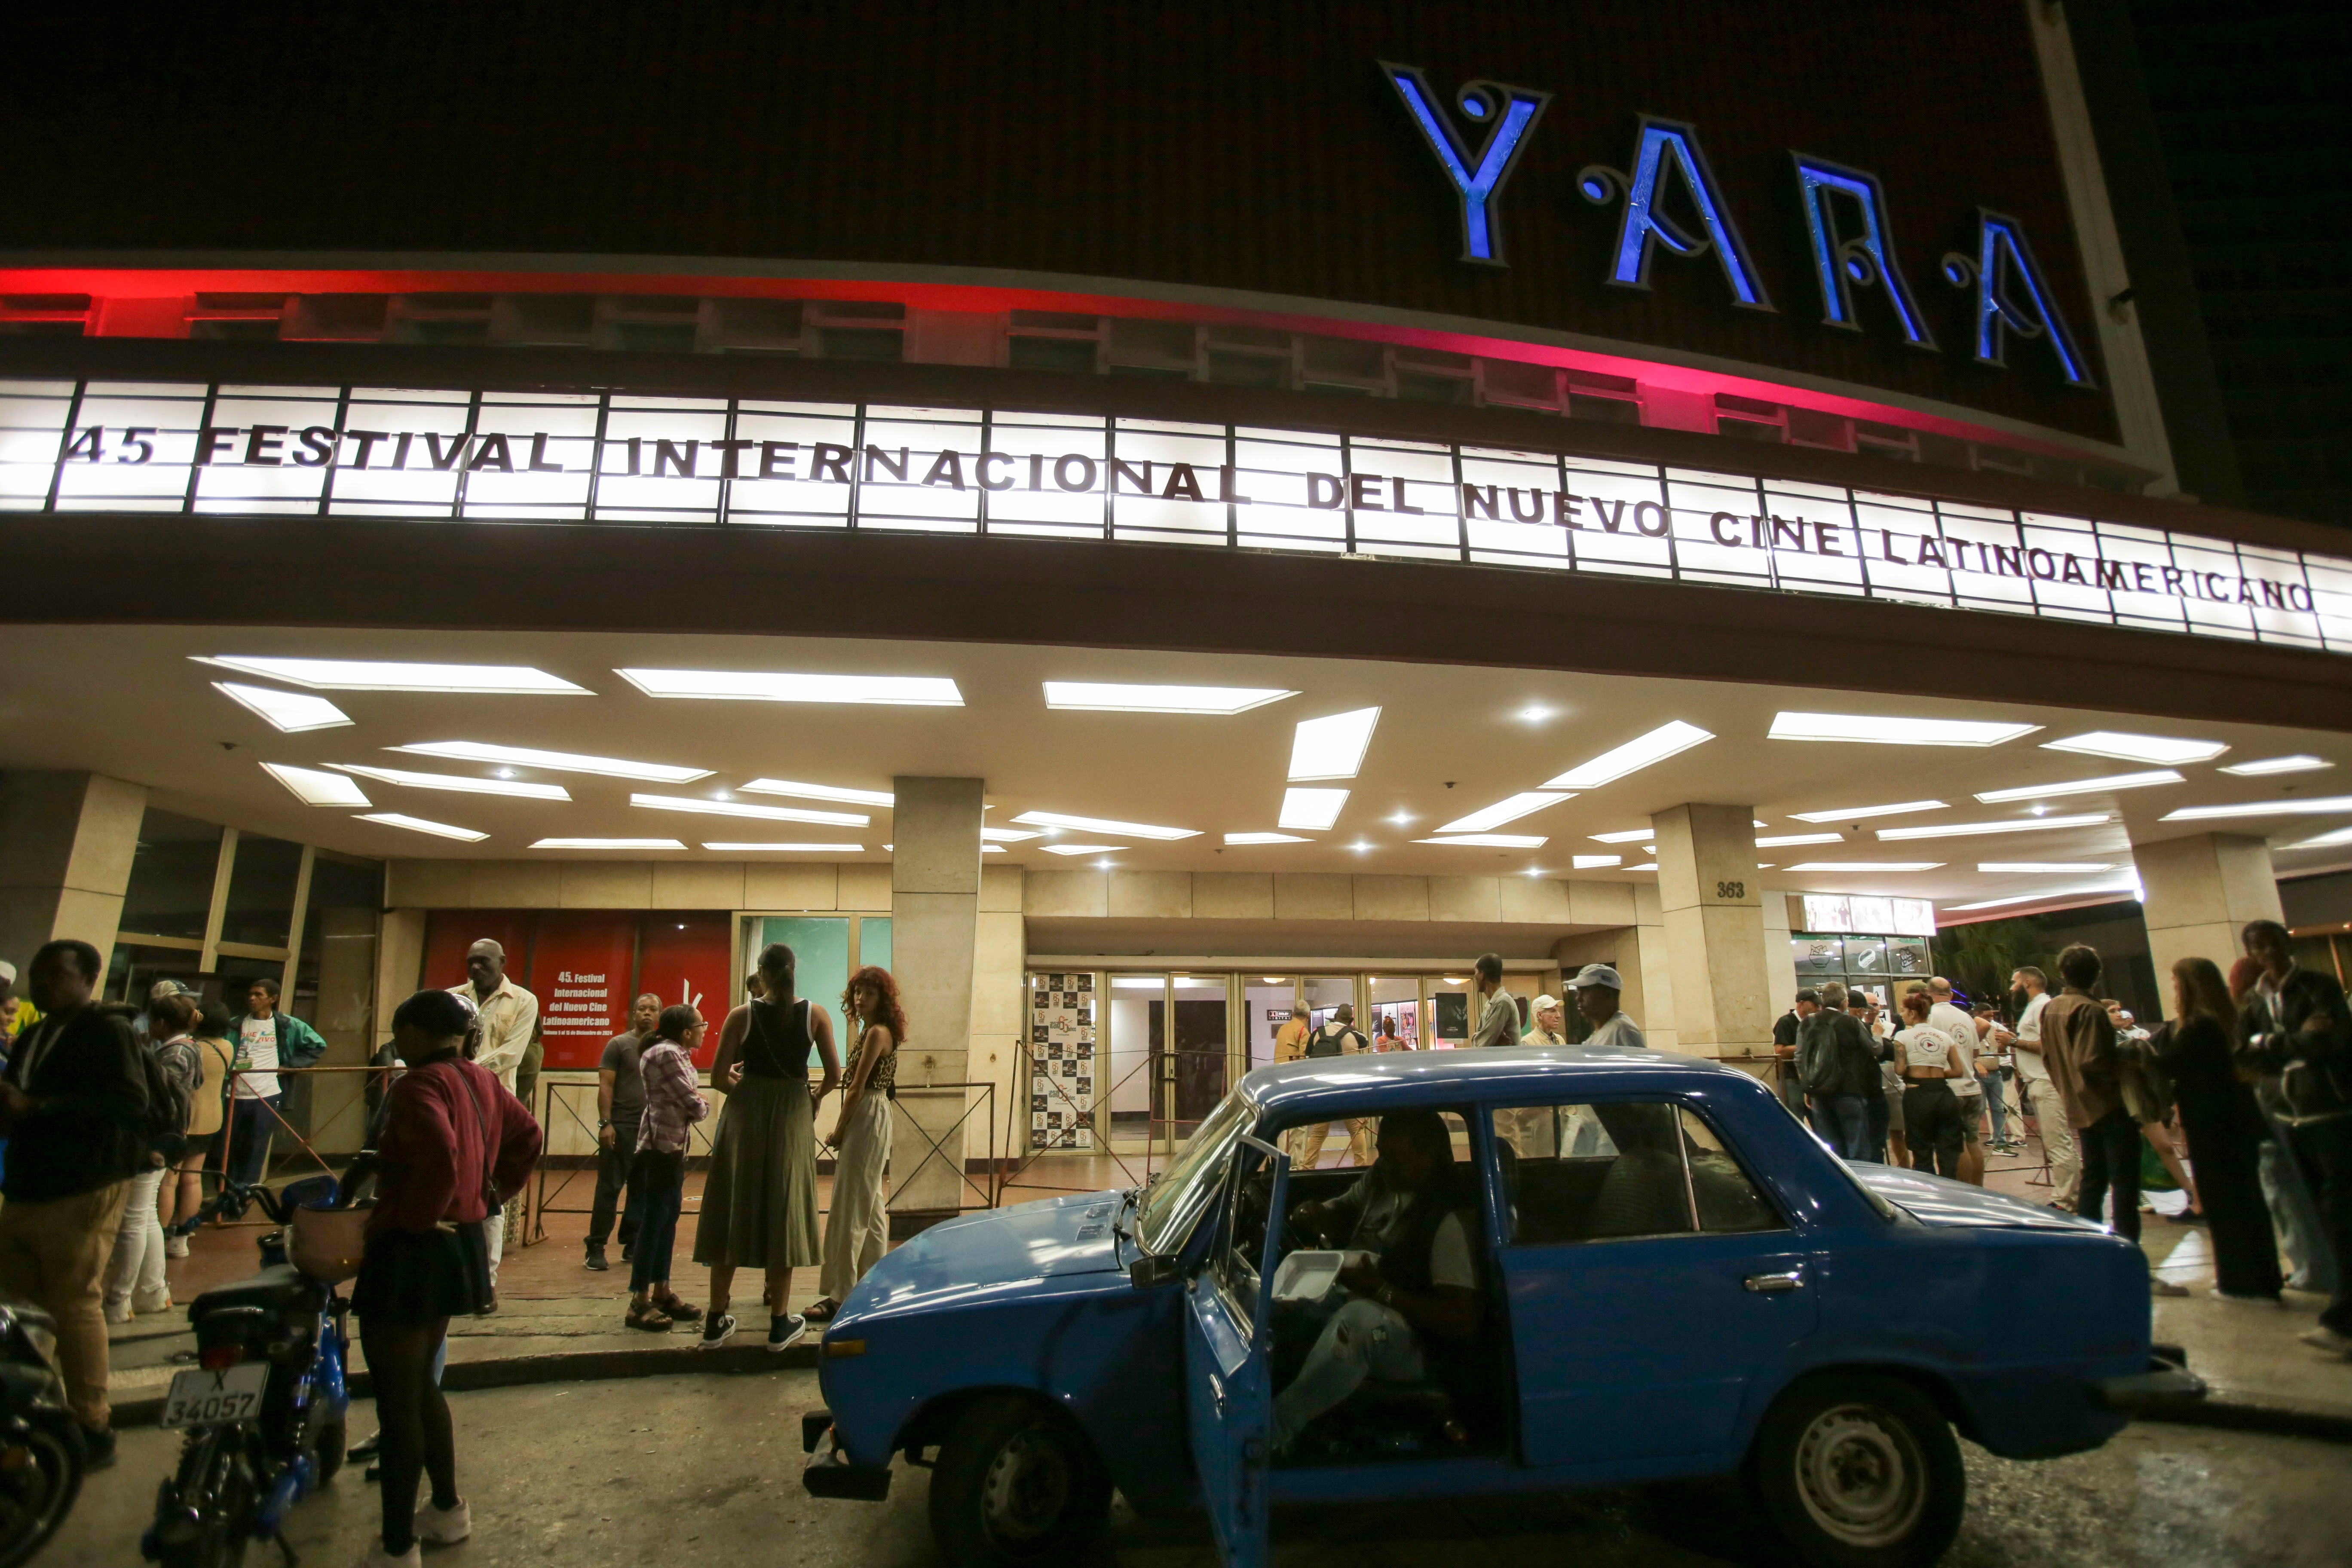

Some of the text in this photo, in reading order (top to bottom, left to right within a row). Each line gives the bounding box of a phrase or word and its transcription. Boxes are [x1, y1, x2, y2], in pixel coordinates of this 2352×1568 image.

[1376, 59, 2098, 389] YARA
[65, 425, 2315, 612] 45 FESTIVAL INTERNACIONAL DEL NUEVO CINE LATINOAMERICANO
[1717, 882, 1744, 898] 363
[558, 971, 605, 983] 45. Festival
[554, 989, 607, 997] Internacional
[549, 1002, 607, 1012] del Nuevo Cine
[543, 1016, 609, 1026] Latinoamericano
[1929, 1032, 1943, 1041] CERO
[210, 1369, 228, 1392] X
[168, 1393, 255, 1424] 34057
